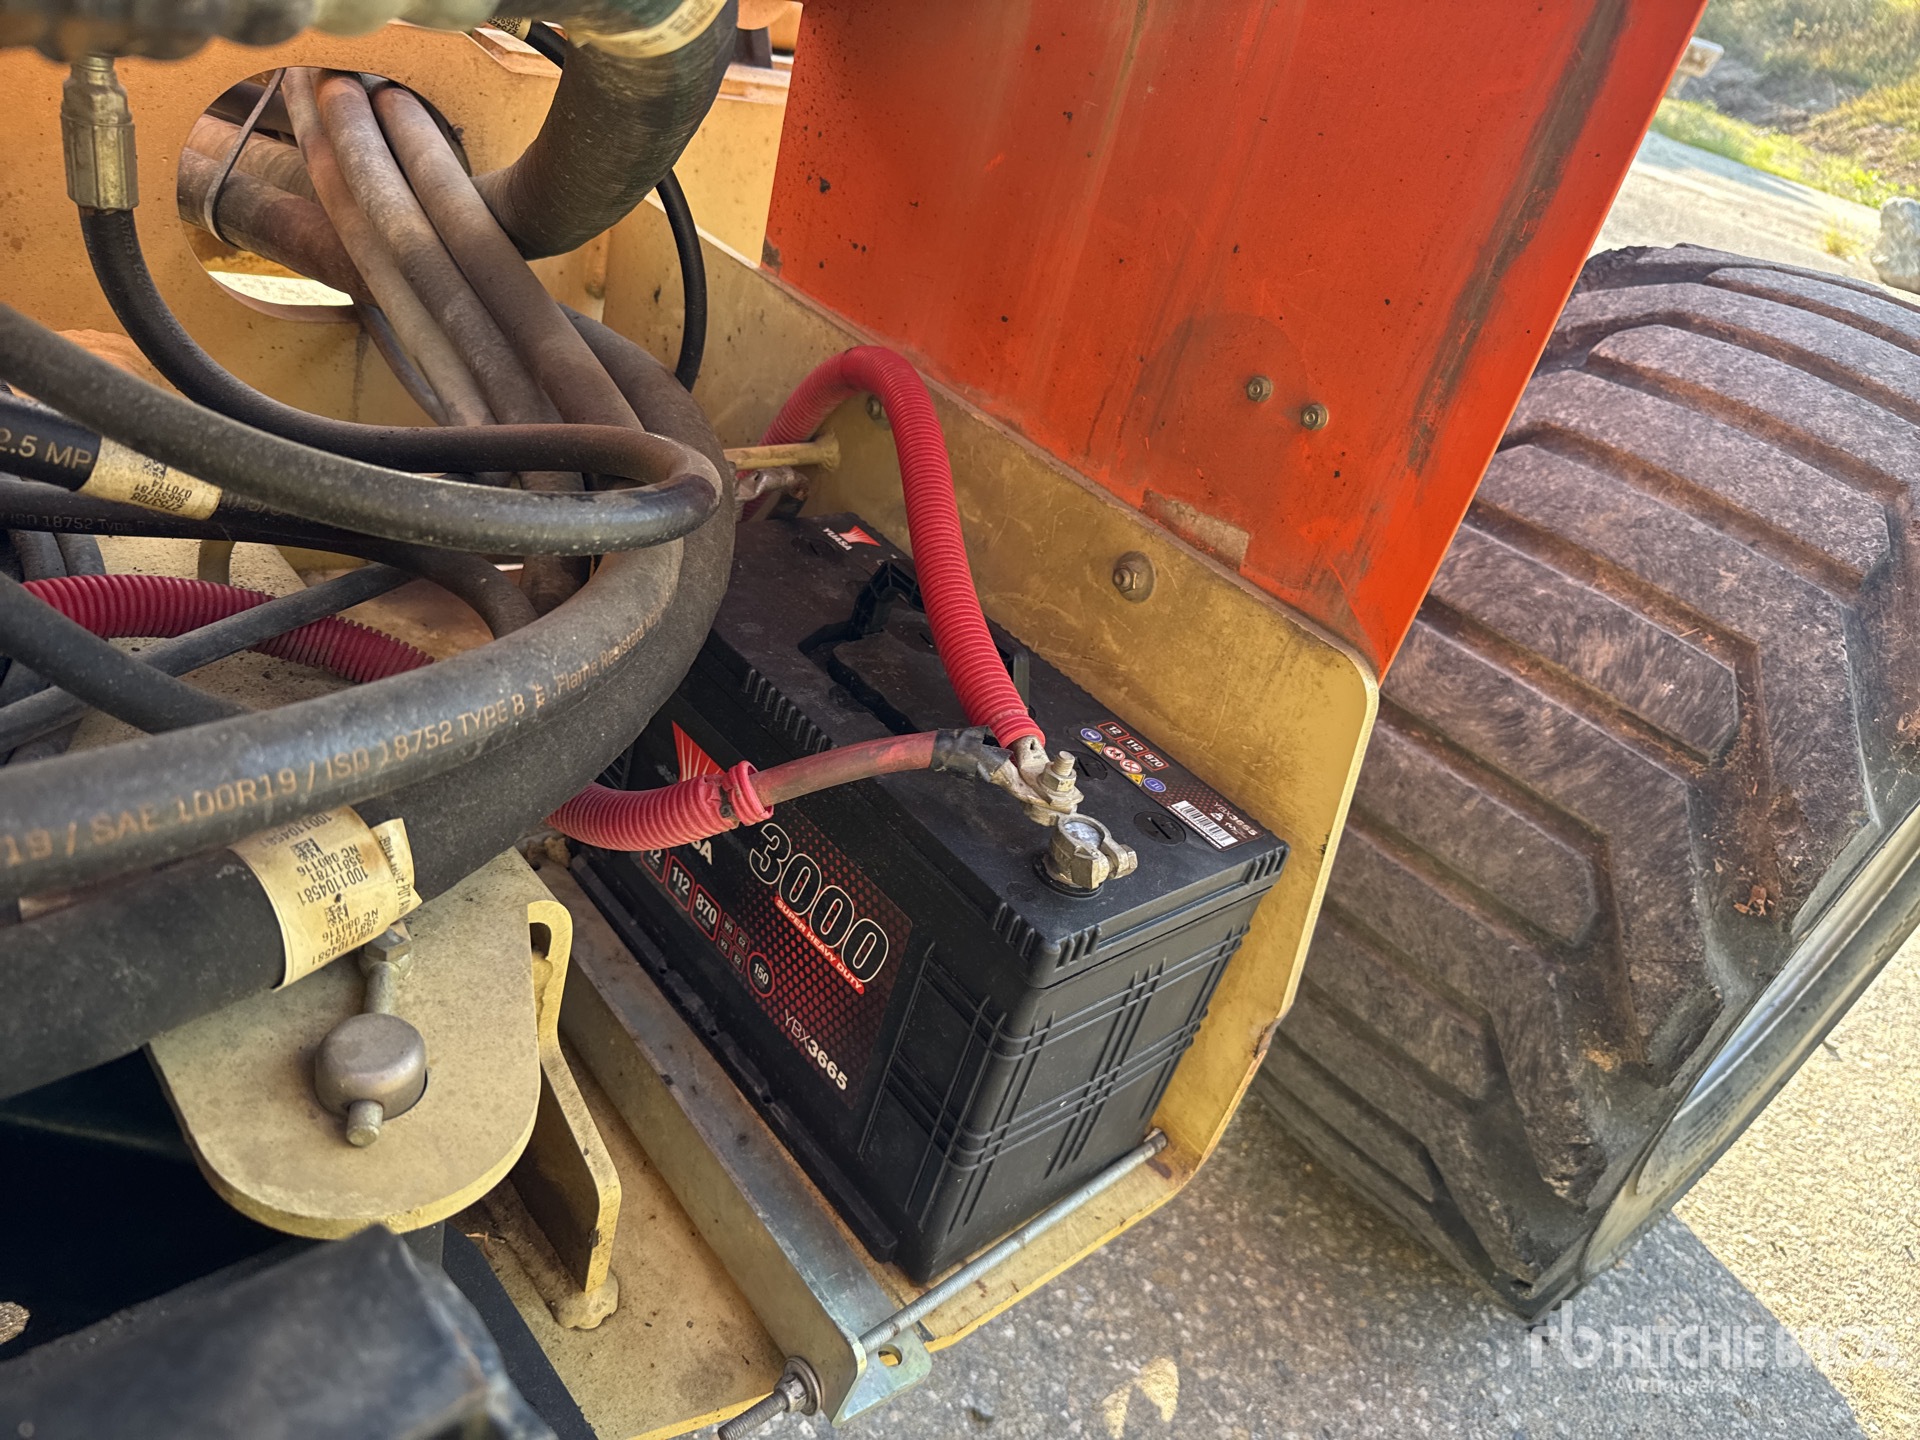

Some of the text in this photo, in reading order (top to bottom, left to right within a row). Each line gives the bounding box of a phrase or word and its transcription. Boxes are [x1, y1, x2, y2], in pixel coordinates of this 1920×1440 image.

[130, 492, 183, 513] 2753708
[134, 483, 189, 506] 36659781
[152, 479, 193, 500] 070114
[42, 515, 94, 530] 18752
[822, 527, 854, 551] YUASA
[88, 803, 157, 846] SAE
[176, 767, 299, 824] 100R19
[326, 746, 371, 782] ISO
[379, 719, 454, 768] 18752
[457, 699, 509, 737] TYPE
[511, 692, 526, 717] B
[555, 660, 600, 695] Flame
[600, 624, 646, 670] Resistant
[1109, 725, 1122, 735] 12
[1126, 738, 1144, 752] 112
[1144, 753, 1165, 768] 870
[297, 844, 360, 877] NC 080116
[310, 854, 365, 884] 35811781
[297, 866, 369, 907] 1001104581
[672, 866, 691, 895] 112
[695, 893, 717, 925] 870
[749, 822, 890, 984] 3000
[775, 898, 863, 990] SUPER HEAVY DUTY
[754, 963, 769, 985] 150
[784, 1008, 848, 1091] YBX3665
